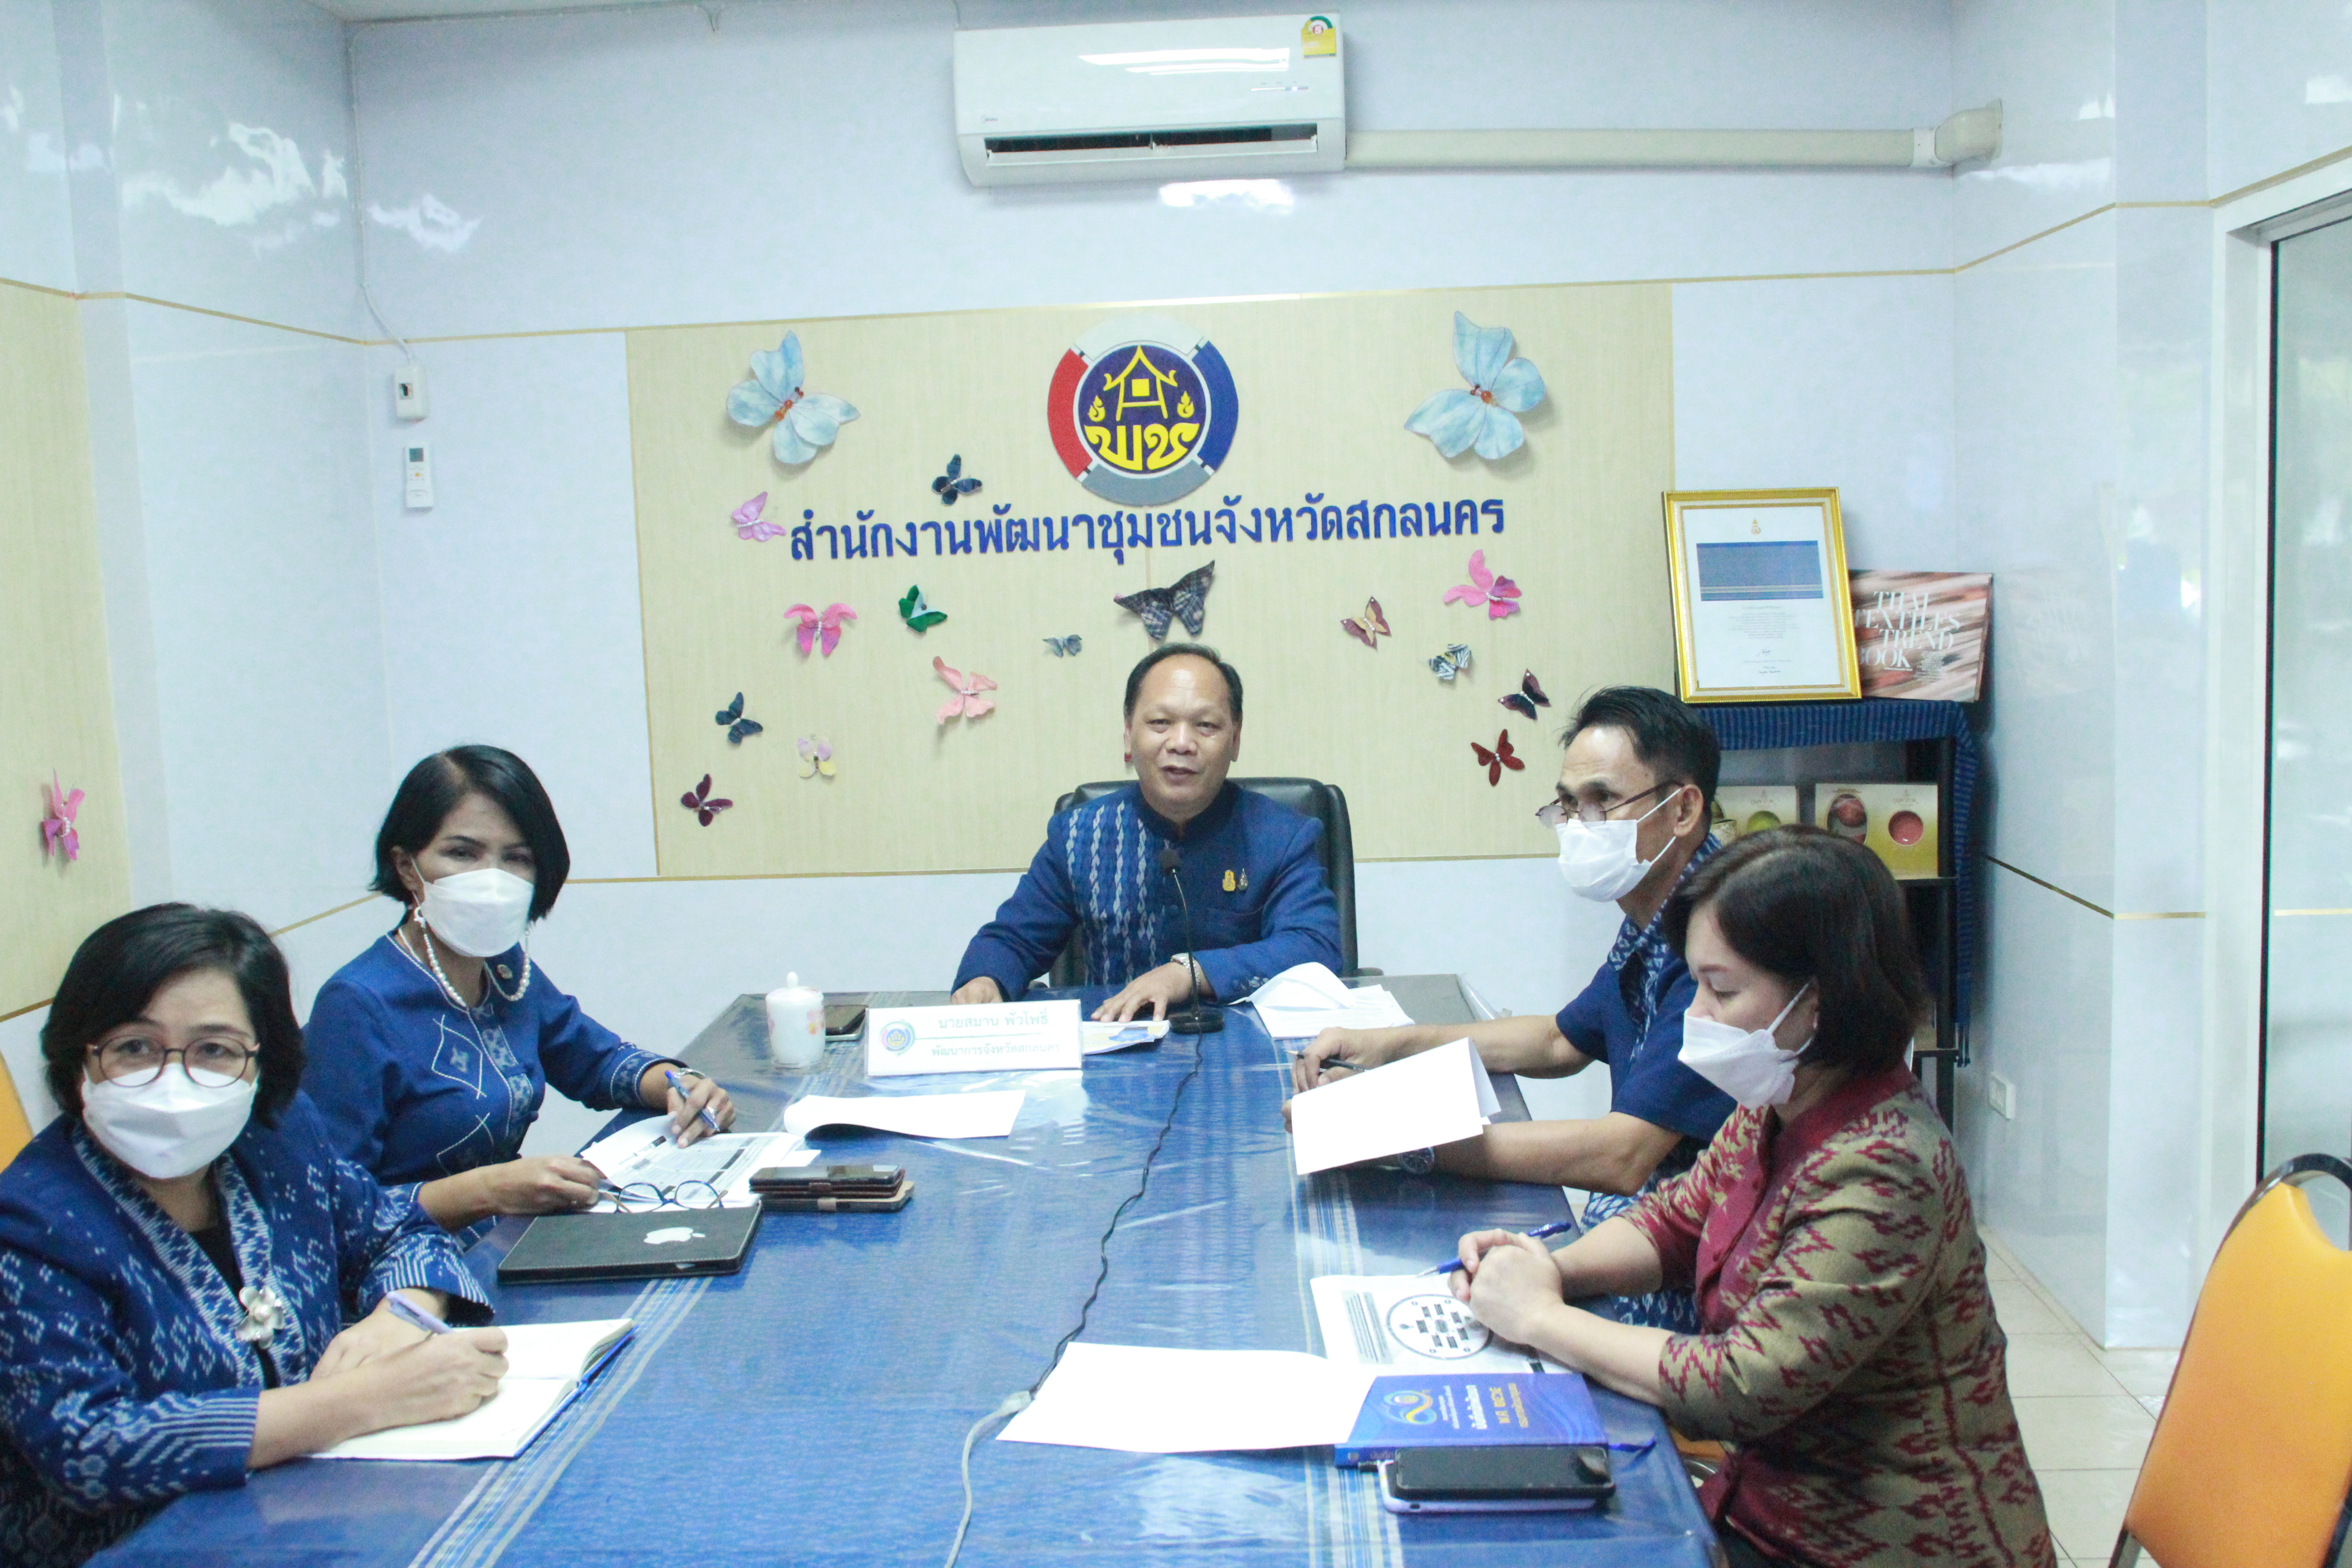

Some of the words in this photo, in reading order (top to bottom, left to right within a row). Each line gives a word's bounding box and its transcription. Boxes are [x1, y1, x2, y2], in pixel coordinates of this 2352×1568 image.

[791, 493, 1504, 564] สำนักงานพัฒนาชุมชนจังหวัดสกลนคร
[1874, 591, 1928, 611] THAI
[1854, 609, 1960, 630] TEXTILES
[1879, 629, 1954, 650] TREND
[938, 1017, 999, 1029] นายสมาน
[931, 1041, 1059, 1056] พัฒนาการจังหวัดสกลนคร
